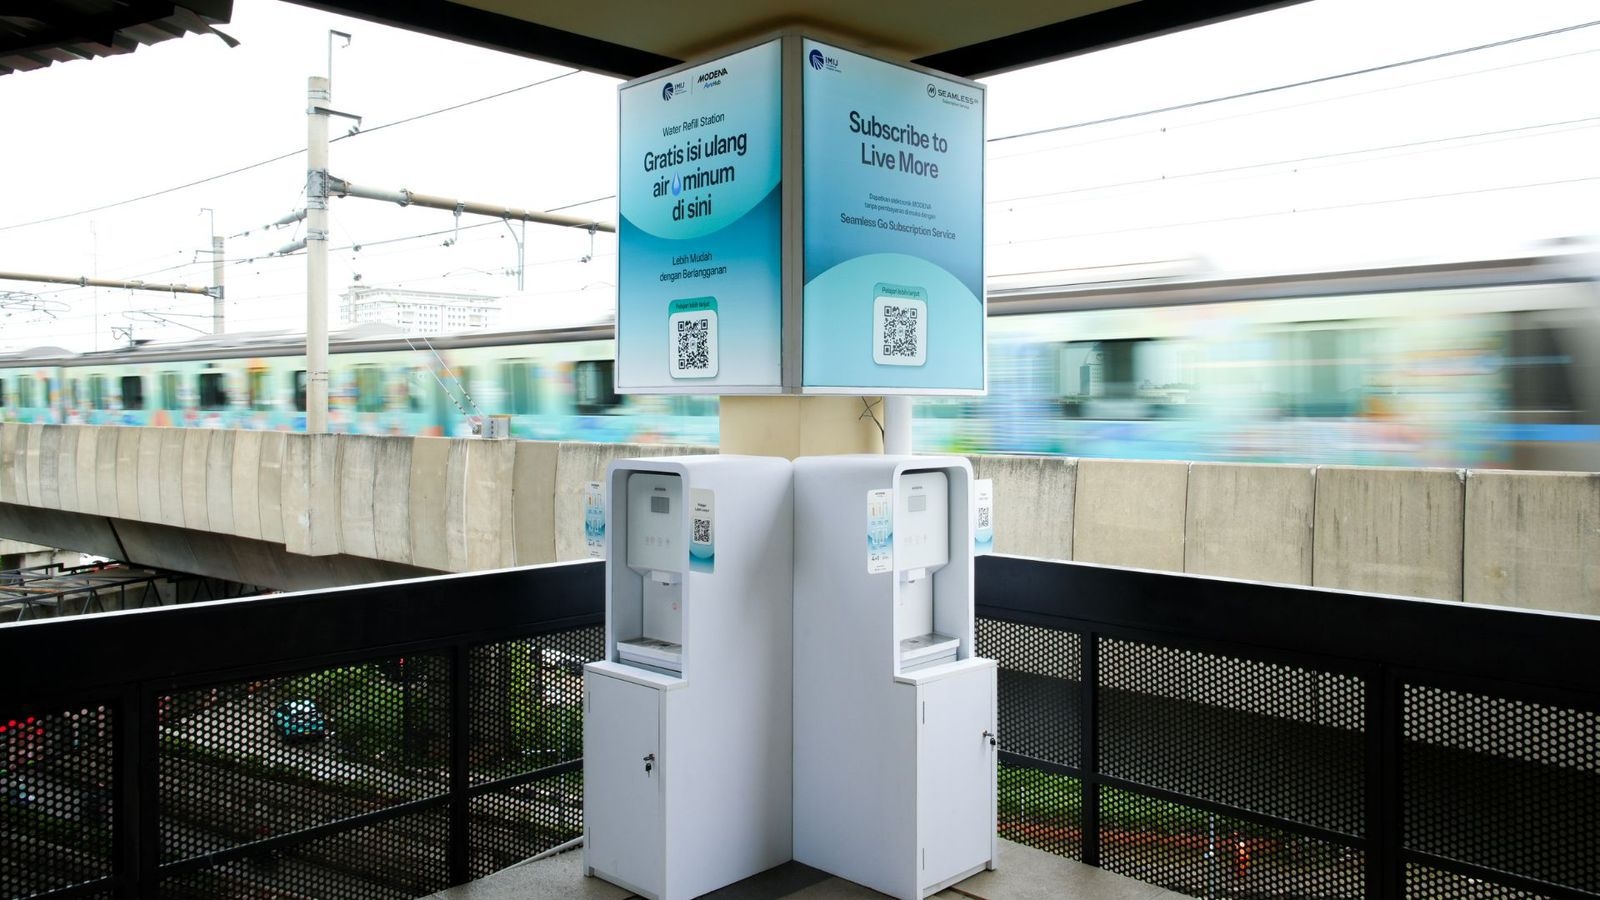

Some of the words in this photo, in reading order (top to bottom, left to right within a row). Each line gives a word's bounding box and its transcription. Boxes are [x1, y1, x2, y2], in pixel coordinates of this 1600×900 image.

[697, 67, 728, 84] MODENA
[937, 89, 974, 104] SEAMLESS
[662, 125, 681, 137] Water
[682, 119, 699, 131] Refill
[700, 113, 725, 127] Station
[849, 110, 930, 149] Subscribe
[932, 132, 948, 153] to
[644, 145, 684, 173] Gratis
[686, 138, 702, 162] isi
[705, 132, 748, 156] ulang
[861, 142, 896, 170] Live
[899, 150, 939, 179] More
[653, 175, 670, 198] air
[683, 166, 735, 191] minum
[672, 196, 685, 222] di
[687, 193, 712, 219] sini
[840, 213, 876, 228] Seamless
[877, 219, 888, 230] Go
[889, 220, 931, 236] Subscription
[932, 227, 956, 240] Service
[672, 253, 689, 266] Lebih
[690, 252, 712, 264] Mudah
[660, 272, 681, 283] dengan
[683, 266, 727, 279] Berlangganan
